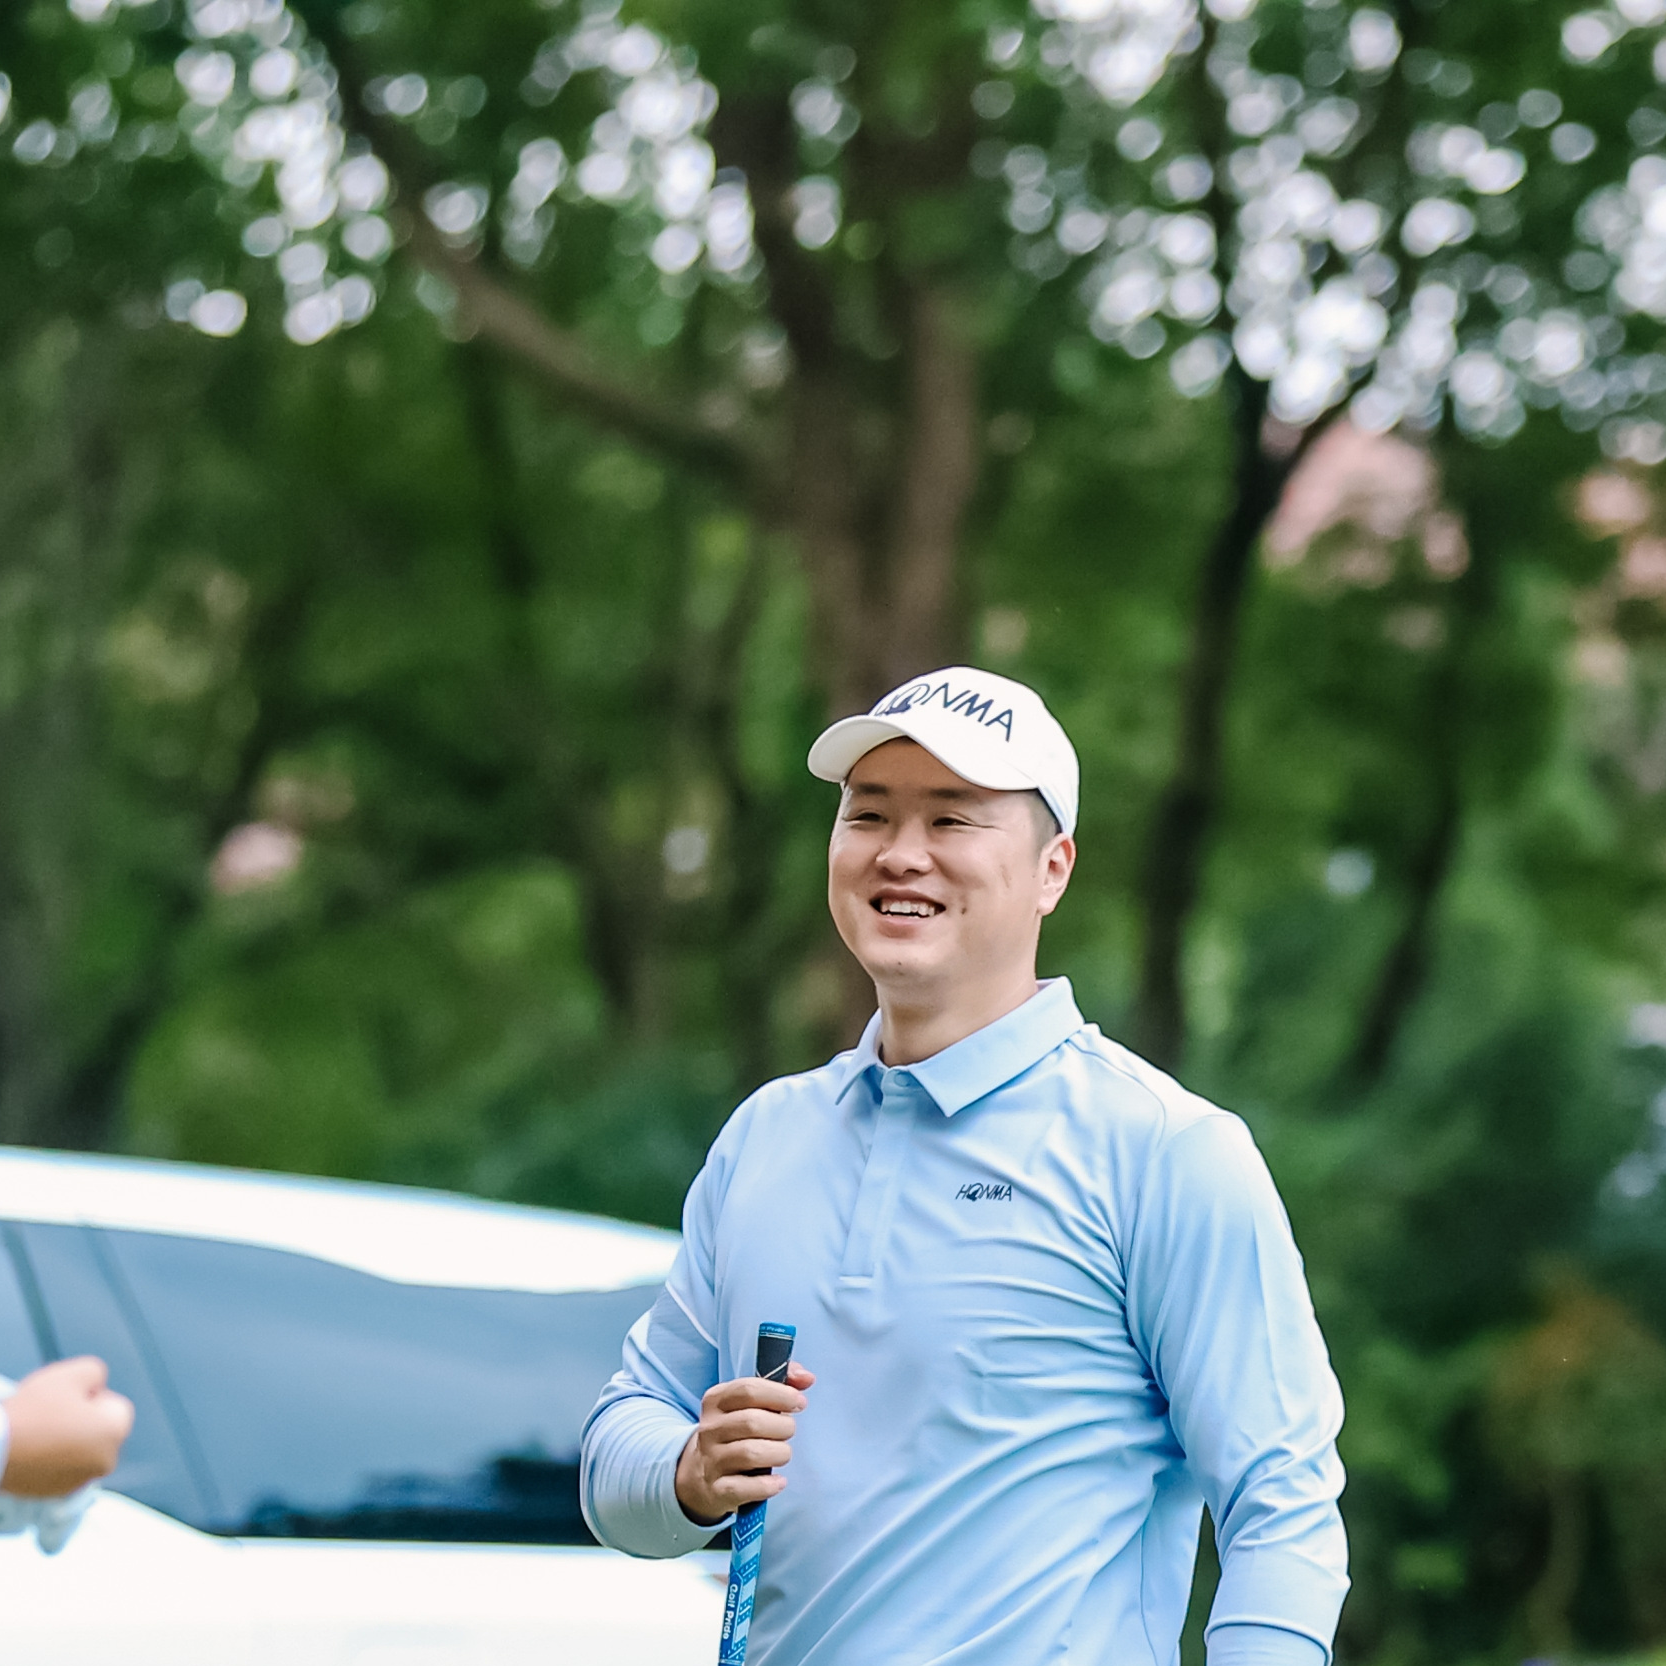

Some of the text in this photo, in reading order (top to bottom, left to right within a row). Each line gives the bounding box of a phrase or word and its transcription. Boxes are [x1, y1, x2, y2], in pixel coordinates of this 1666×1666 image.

[955, 1182, 1012, 1202] HONMA
[722, 1583, 739, 1640] Golf Pride
